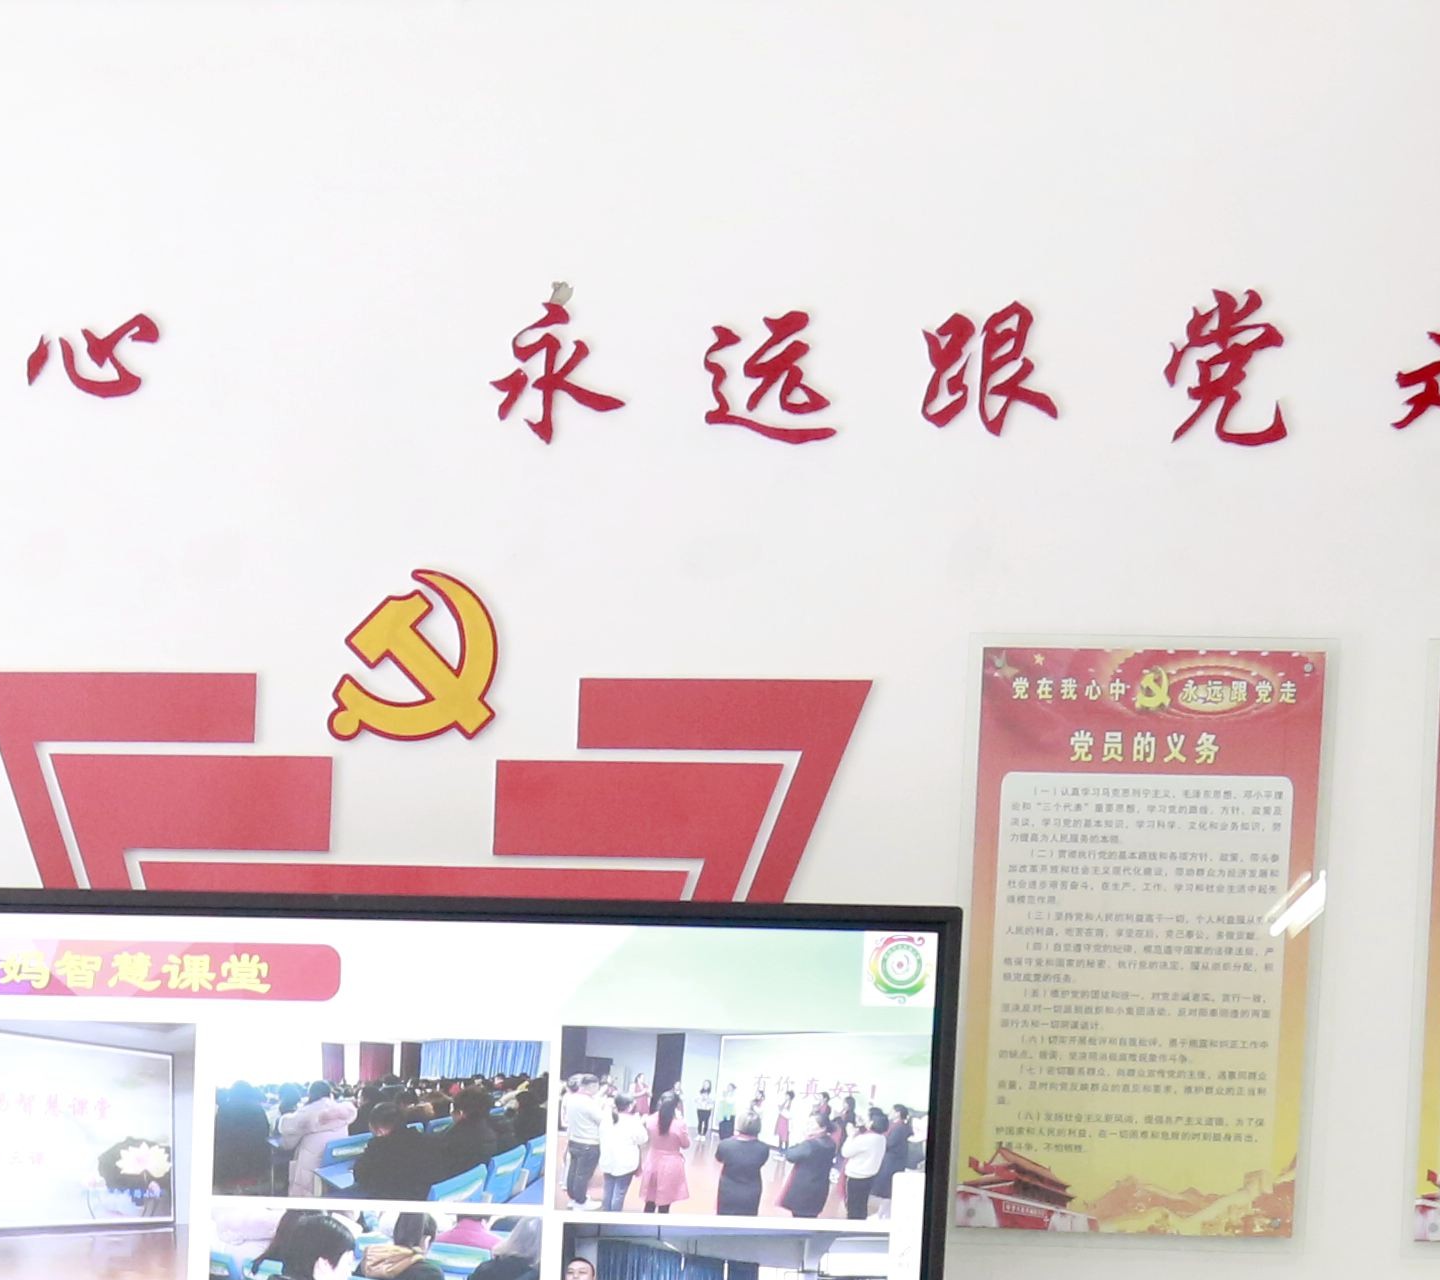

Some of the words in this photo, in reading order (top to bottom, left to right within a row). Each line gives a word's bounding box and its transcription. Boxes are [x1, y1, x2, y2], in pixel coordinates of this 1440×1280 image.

[1012, 677, 1127, 701] 党在我心中
[1181, 679, 1298, 705] 永远跟党走
[1069, 729, 1221, 765] 党员的义务
